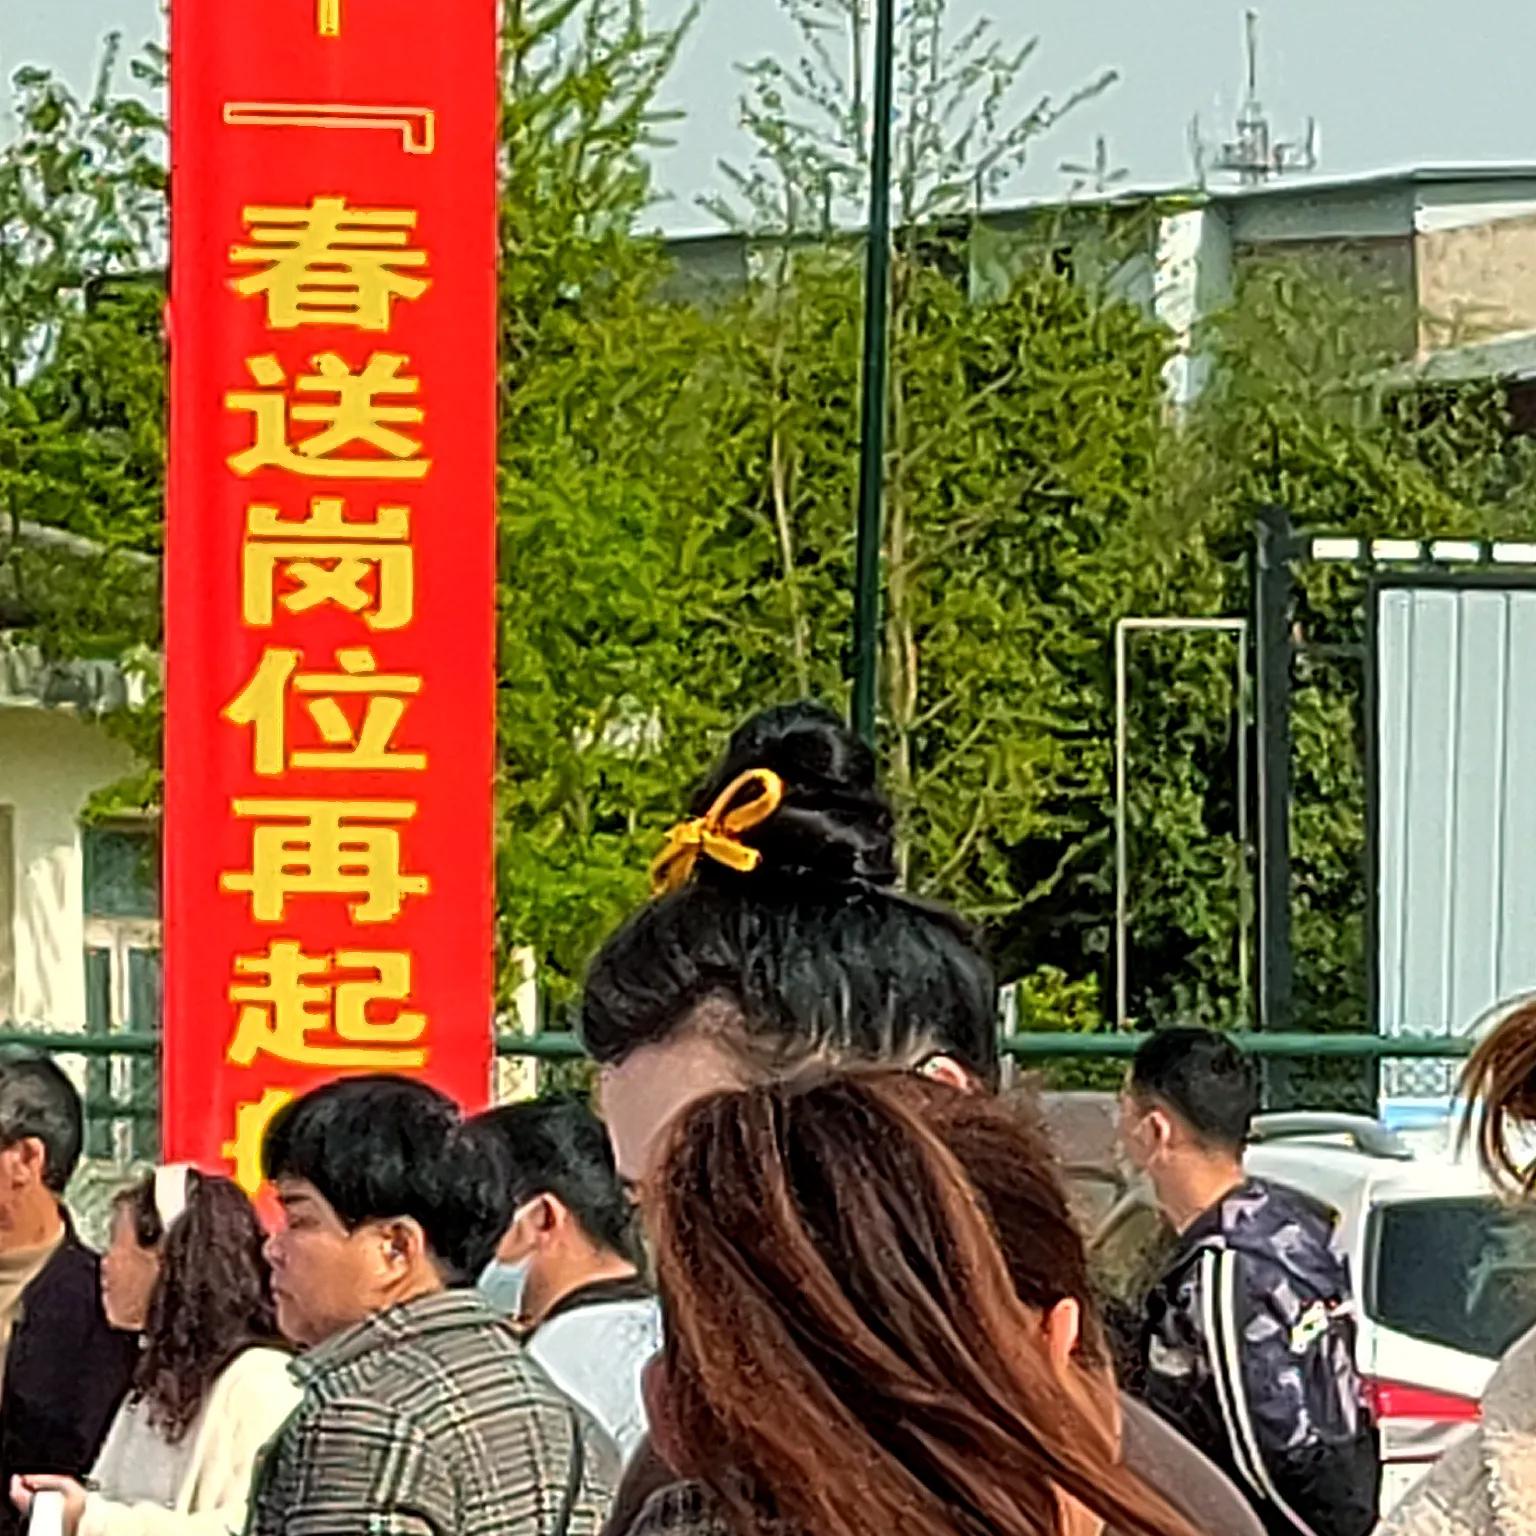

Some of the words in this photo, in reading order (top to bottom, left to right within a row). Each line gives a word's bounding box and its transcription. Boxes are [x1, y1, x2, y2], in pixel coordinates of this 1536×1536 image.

[219, 0, 436, 1197] 『春送岗位再起
